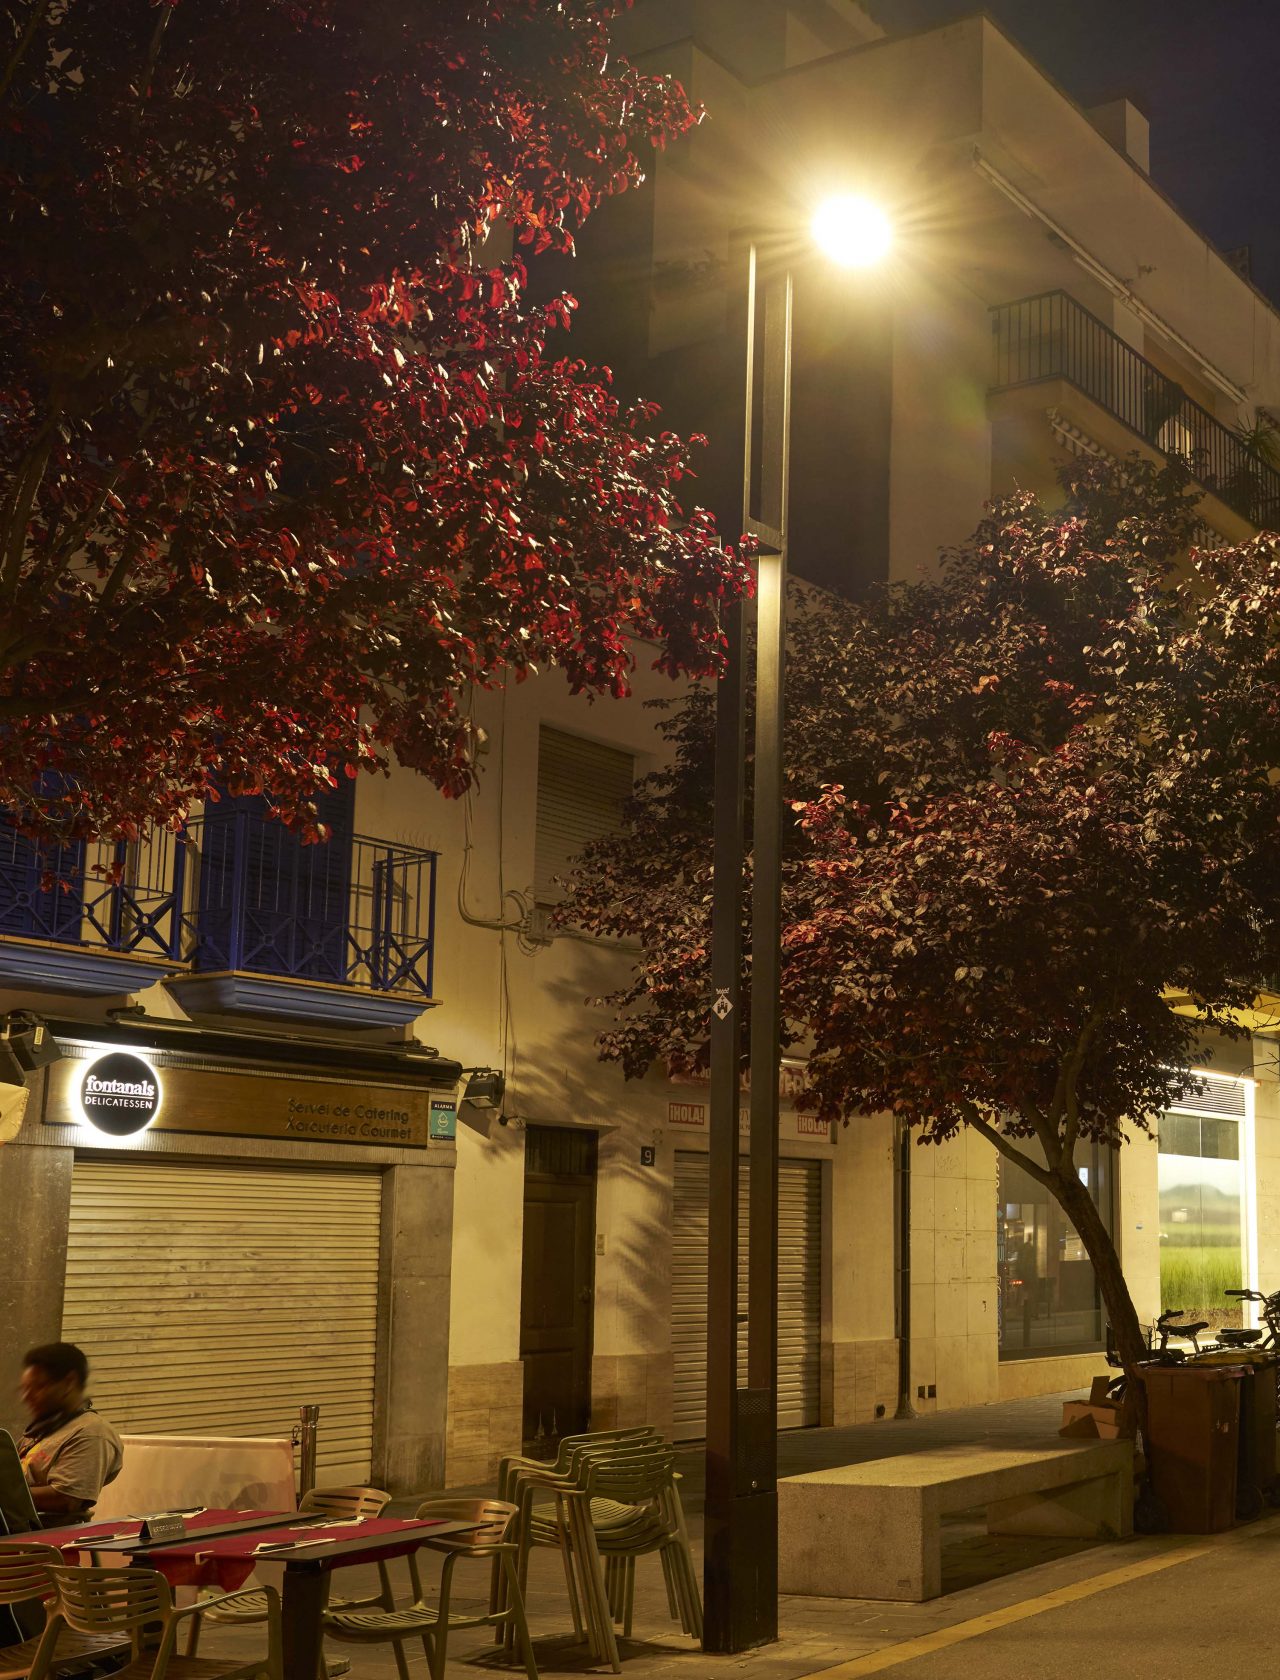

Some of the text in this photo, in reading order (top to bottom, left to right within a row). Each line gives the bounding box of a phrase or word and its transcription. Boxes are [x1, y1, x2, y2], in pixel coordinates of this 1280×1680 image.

[86, 1075, 154, 1096] fontanals
[85, 1096, 152, 1109] DELICATESSEN
[288, 1099, 409, 1124] Servei de Catering
[670, 1105, 703, 1123] ¡HOLA!
[285, 1116, 412, 1140] Xarcuteria Gourmet
[798, 1116, 828, 1135] ¡HOLA!
[644, 1150, 652, 1164] 9
